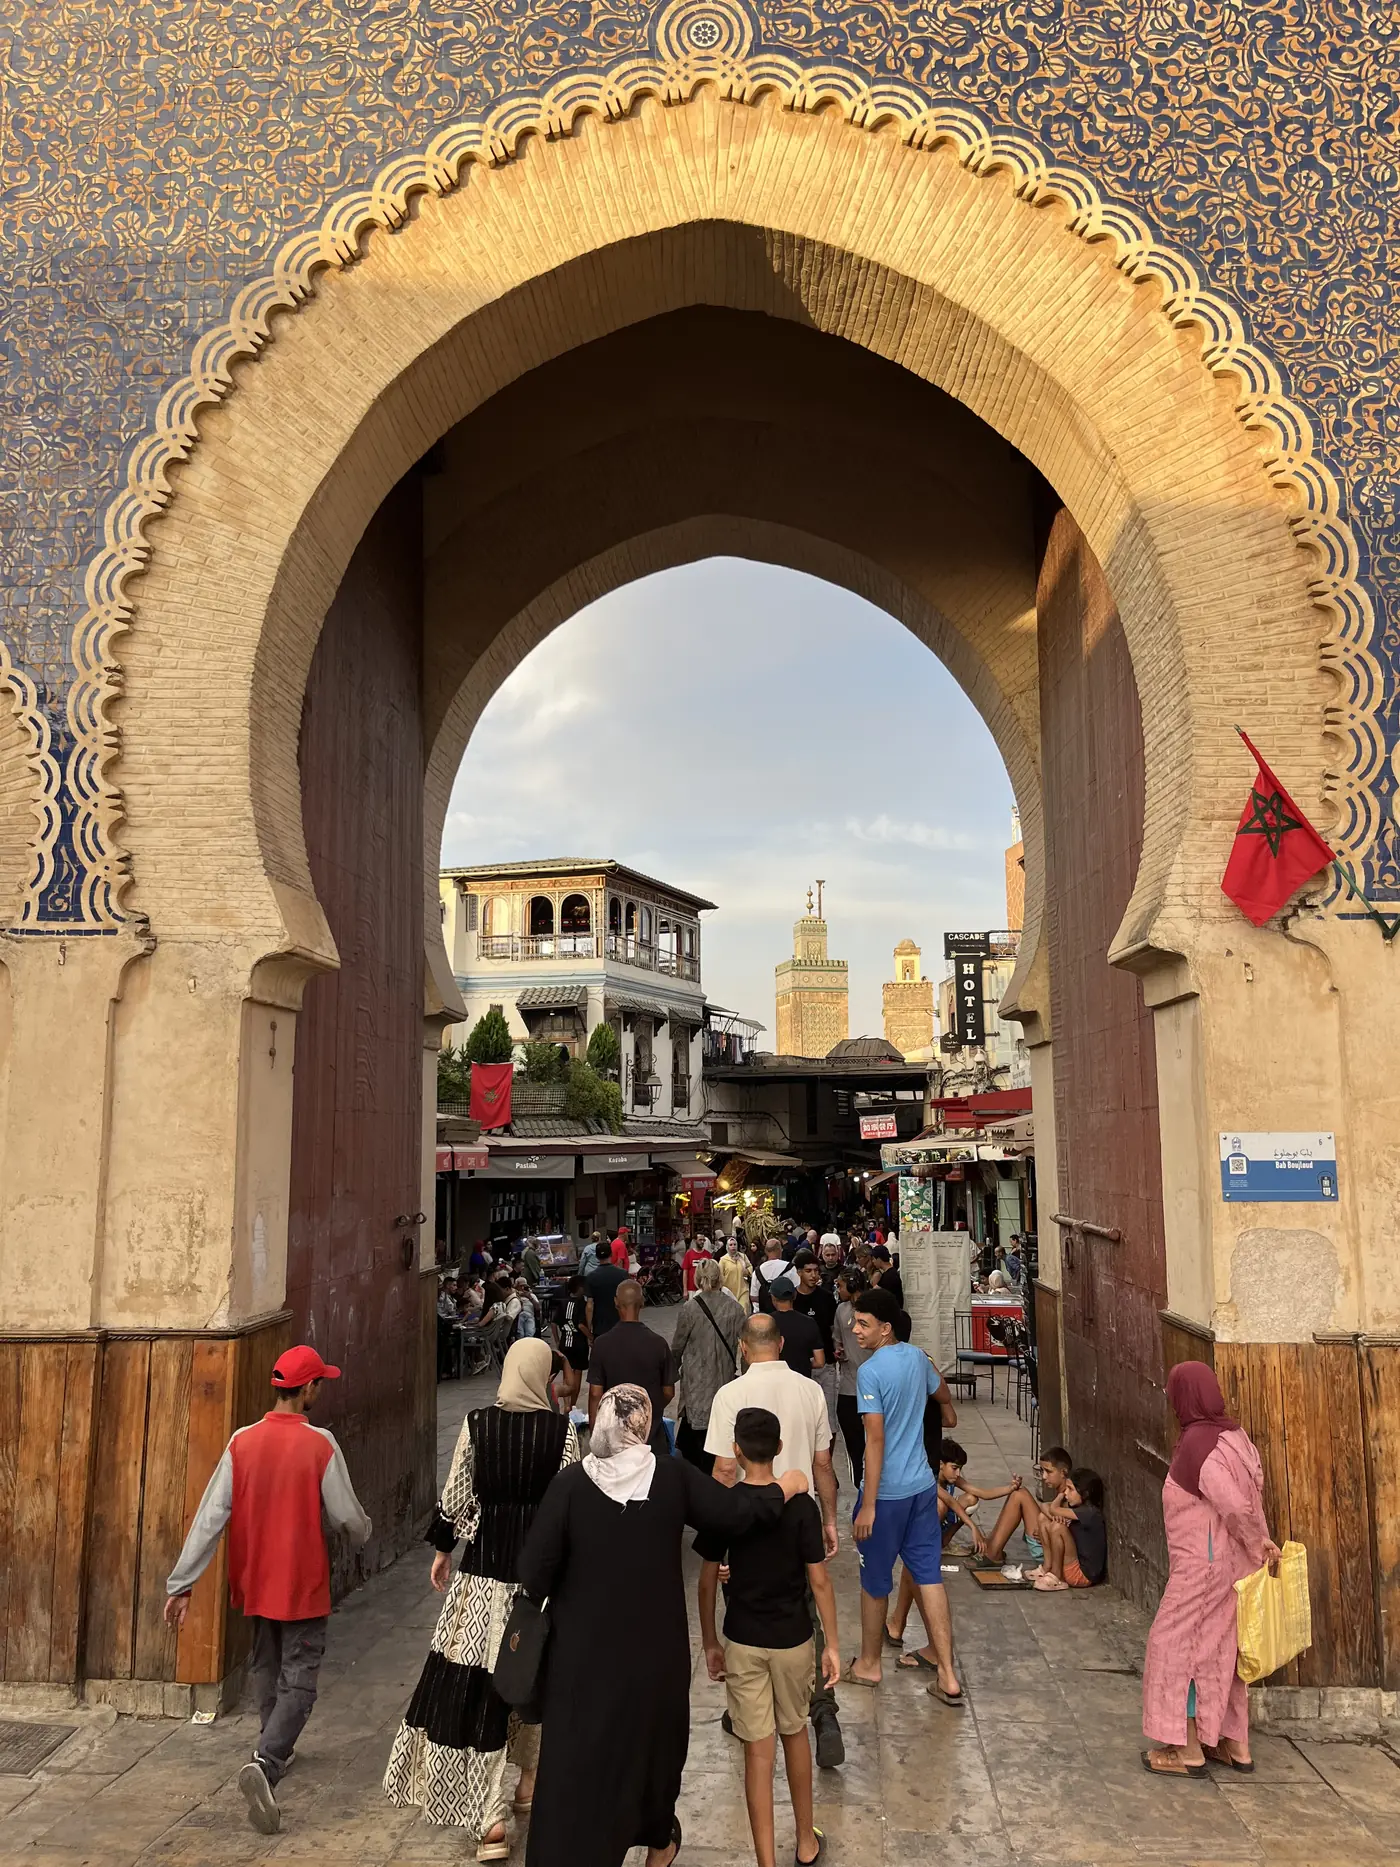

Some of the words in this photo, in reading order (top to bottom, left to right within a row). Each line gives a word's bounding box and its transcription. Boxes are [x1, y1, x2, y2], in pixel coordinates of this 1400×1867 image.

[948, 933, 985, 941] CASCADE
[962, 963, 977, 1040] HOTEL
[1275, 1161, 1286, 1169] Bab
[1287, 1161, 1313, 1170] Boujloud
